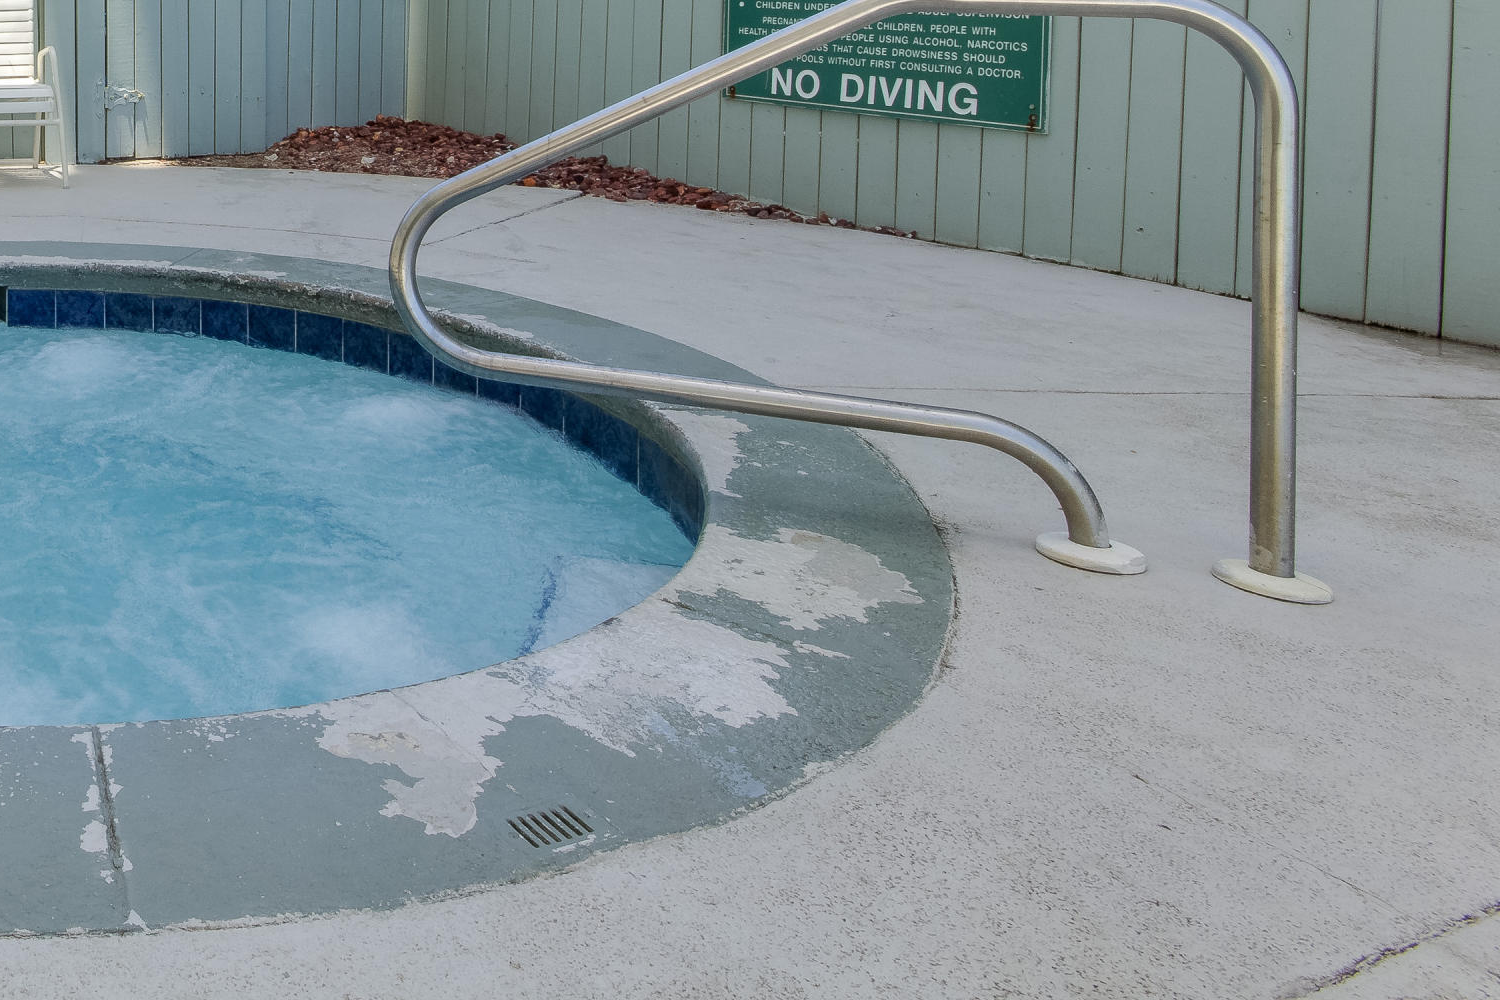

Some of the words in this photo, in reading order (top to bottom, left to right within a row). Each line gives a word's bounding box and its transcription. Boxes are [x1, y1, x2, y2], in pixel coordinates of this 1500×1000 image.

[756, 1, 800, 10] CHILDREN
[762, 16, 803, 25] PREGNA
[930, 24, 967, 35] PEOPLE
[971, 26, 996, 36] WITH
[738, 27, 768, 36] HEALTH
[879, 35, 909, 45] USING
[967, 40, 1028, 52] NARCOTICS
[832, 44, 854, 53] THAT
[857, 46, 888, 56] CAUSE
[892, 48, 958, 61] DROWSINESS
[963, 53, 1006, 64] SHOULD
[827, 56, 866, 67] WITHOUT
[870, 59, 896, 70] FIRST
[900, 62, 962, 75] CONSULTING
[966, 66, 973, 75] A
[771, 67, 820, 99] NO
[840, 73, 978, 116] DIVING
